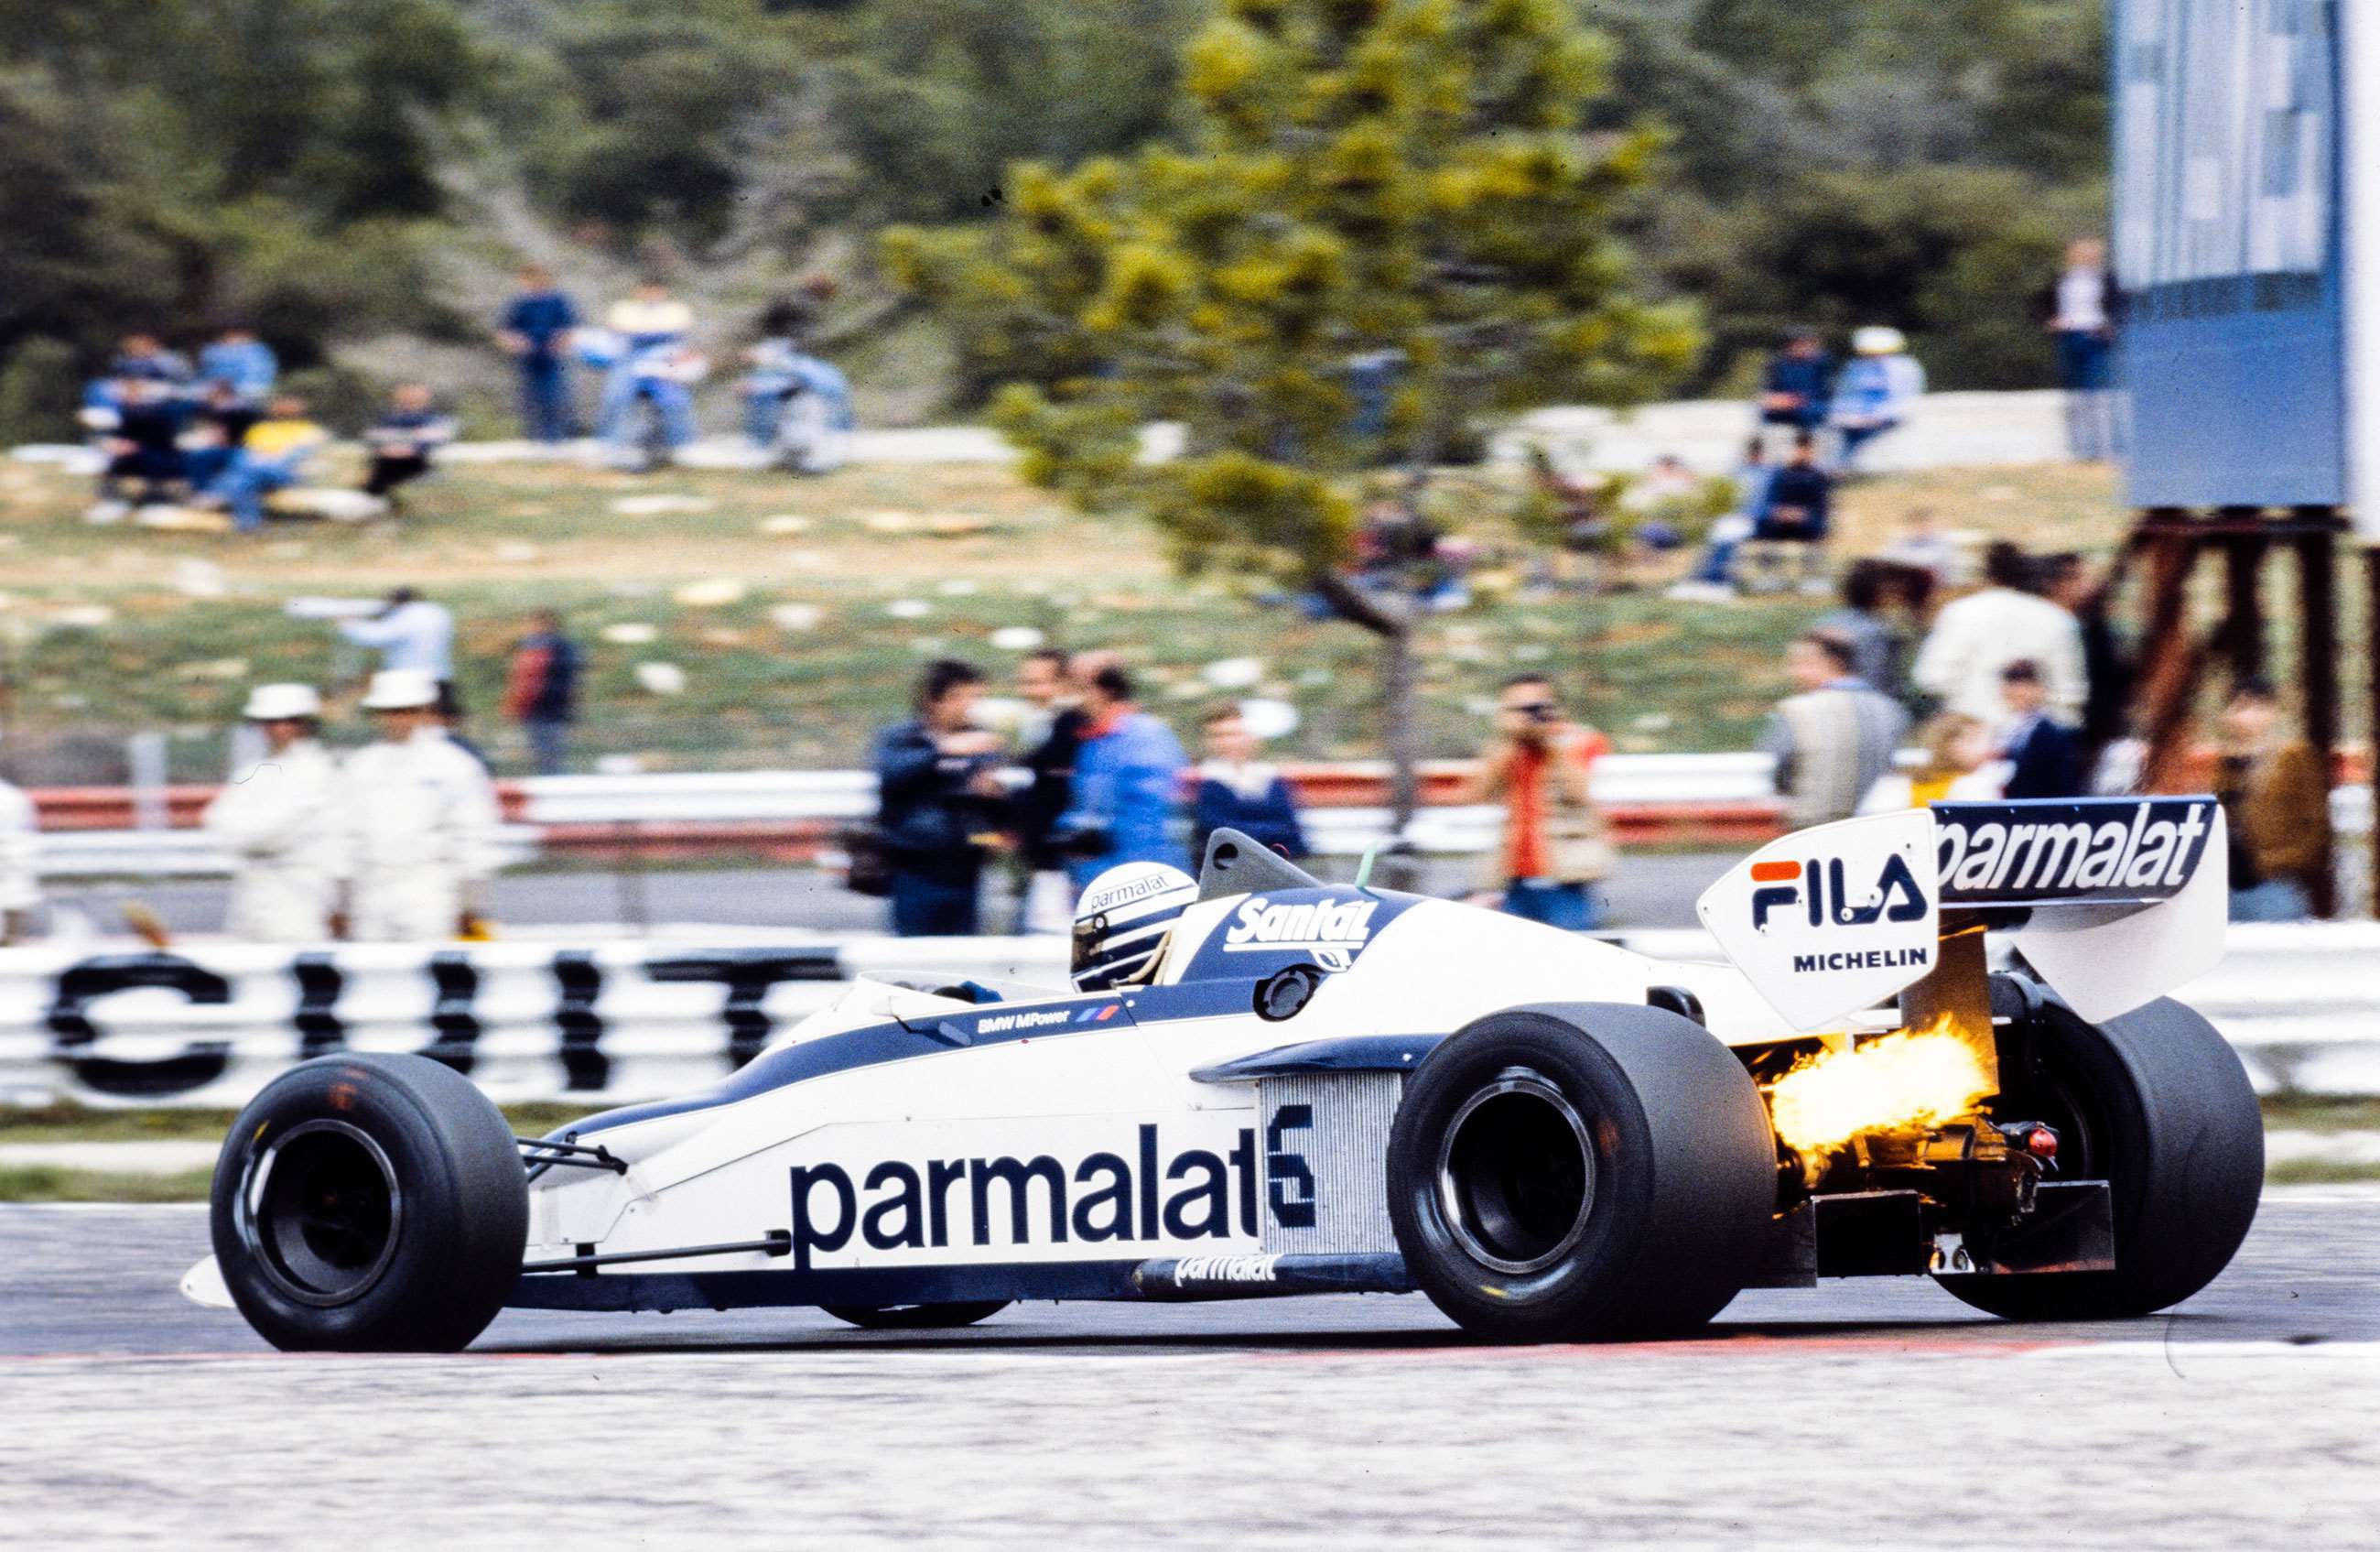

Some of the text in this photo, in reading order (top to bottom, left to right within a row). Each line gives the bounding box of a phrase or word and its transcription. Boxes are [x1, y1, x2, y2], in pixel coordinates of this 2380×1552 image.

[1935, 802, 2204, 891] parmalat
[1090, 874, 1170, 915] parmalat
[1749, 852, 1929, 933] FILA
[1792, 947, 1928, 973] MICHELIN
[977, 1015, 1015, 1034] BMW
[788, 1123, 1259, 1271] parmalat
[1267, 1104, 1316, 1228] 6
